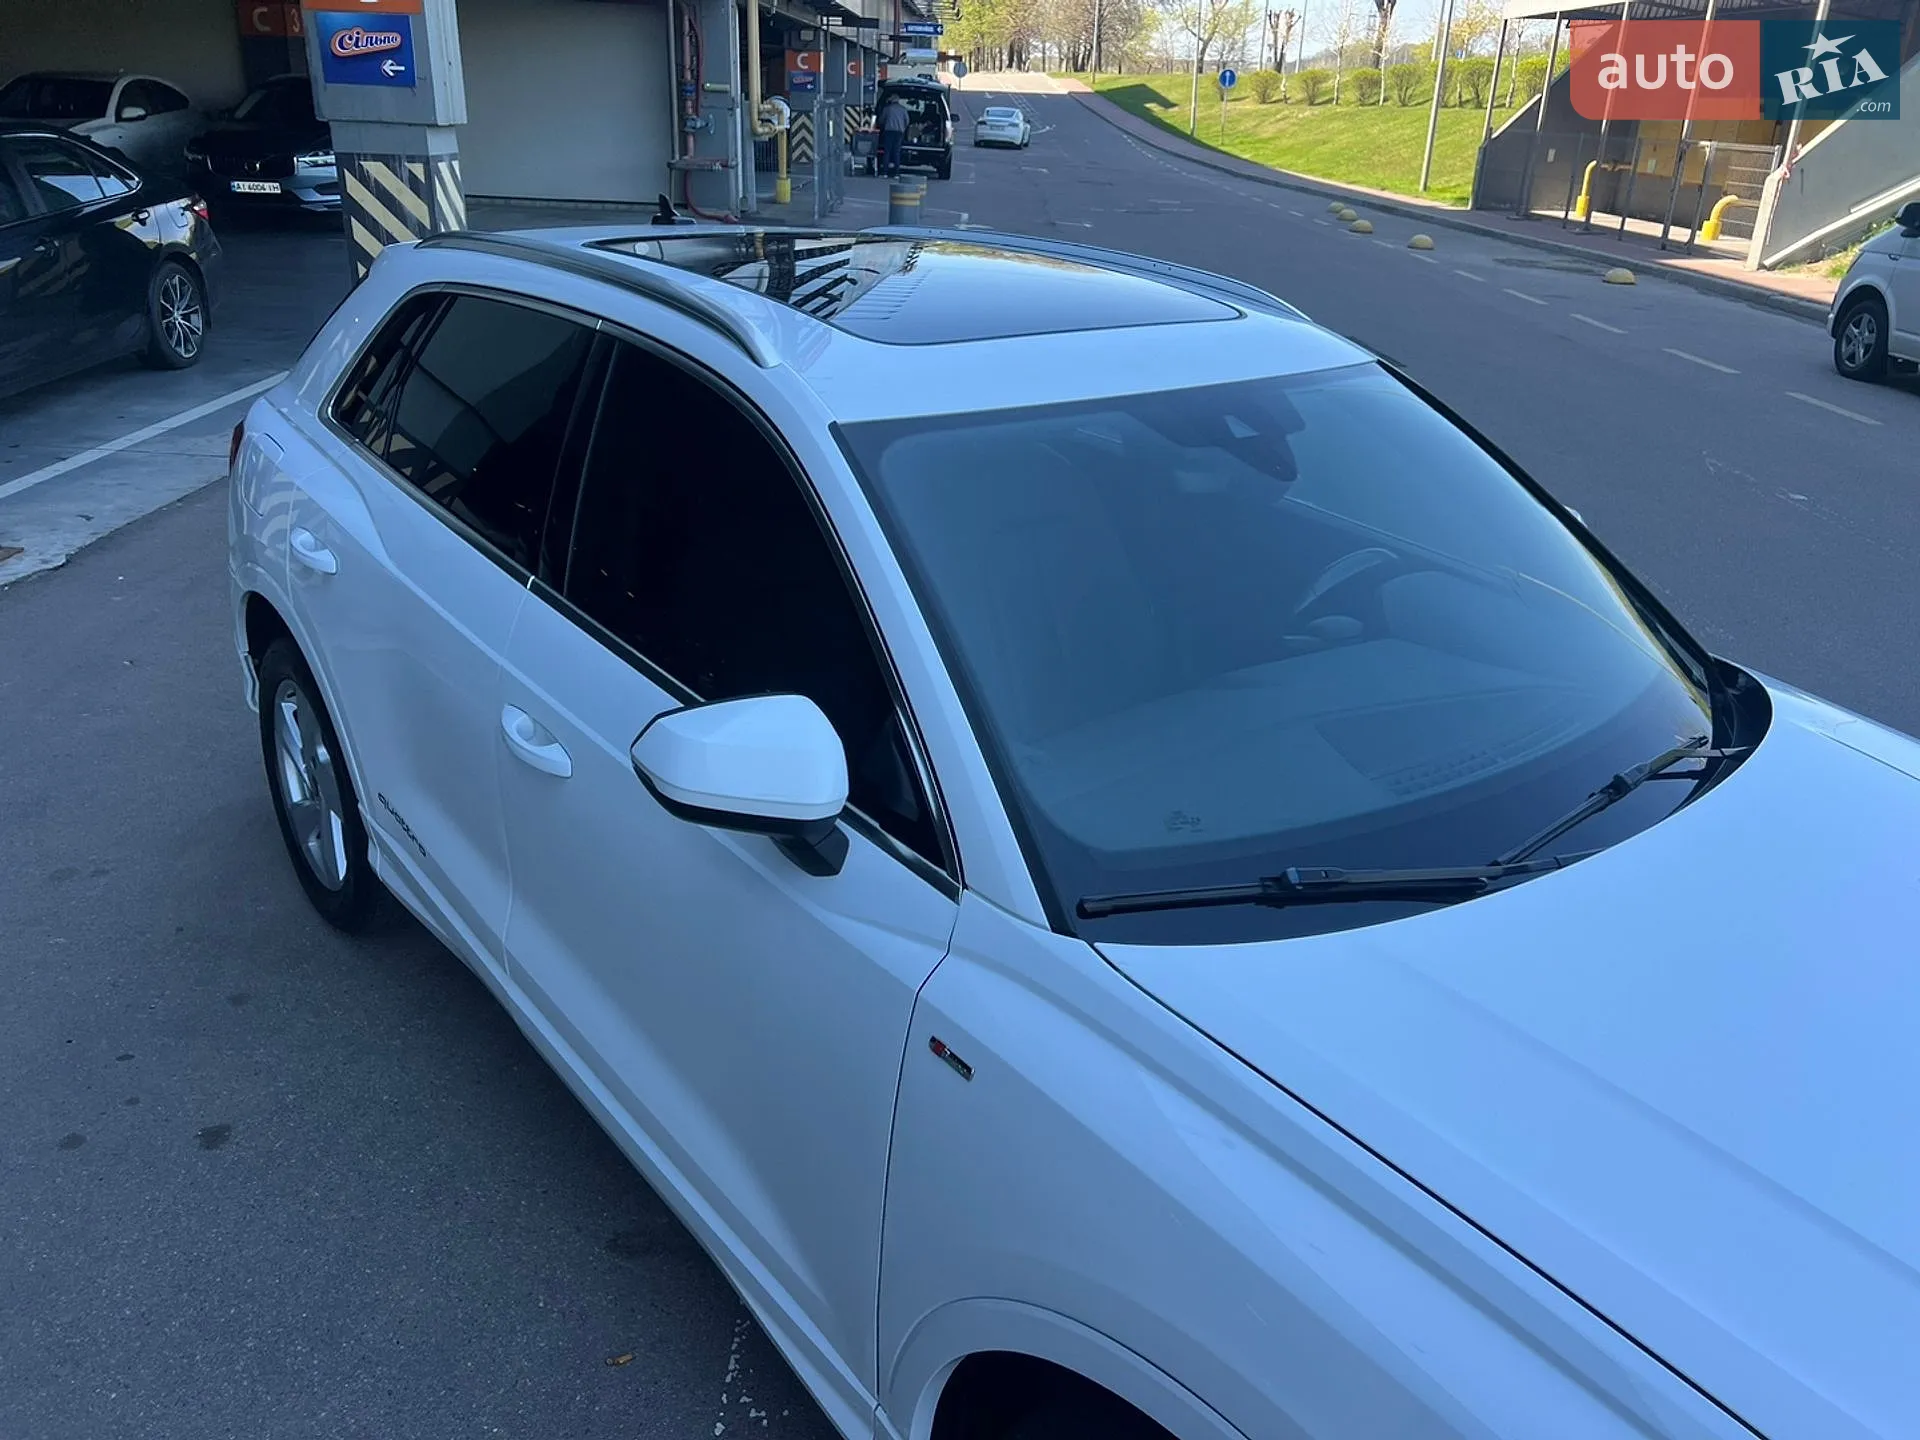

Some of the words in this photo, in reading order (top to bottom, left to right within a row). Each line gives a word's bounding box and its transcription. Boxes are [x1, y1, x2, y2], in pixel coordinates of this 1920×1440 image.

[336, 30, 399, 53] Сільпо
[797, 53, 809, 69] C
[377, 792, 427, 857] quattro
